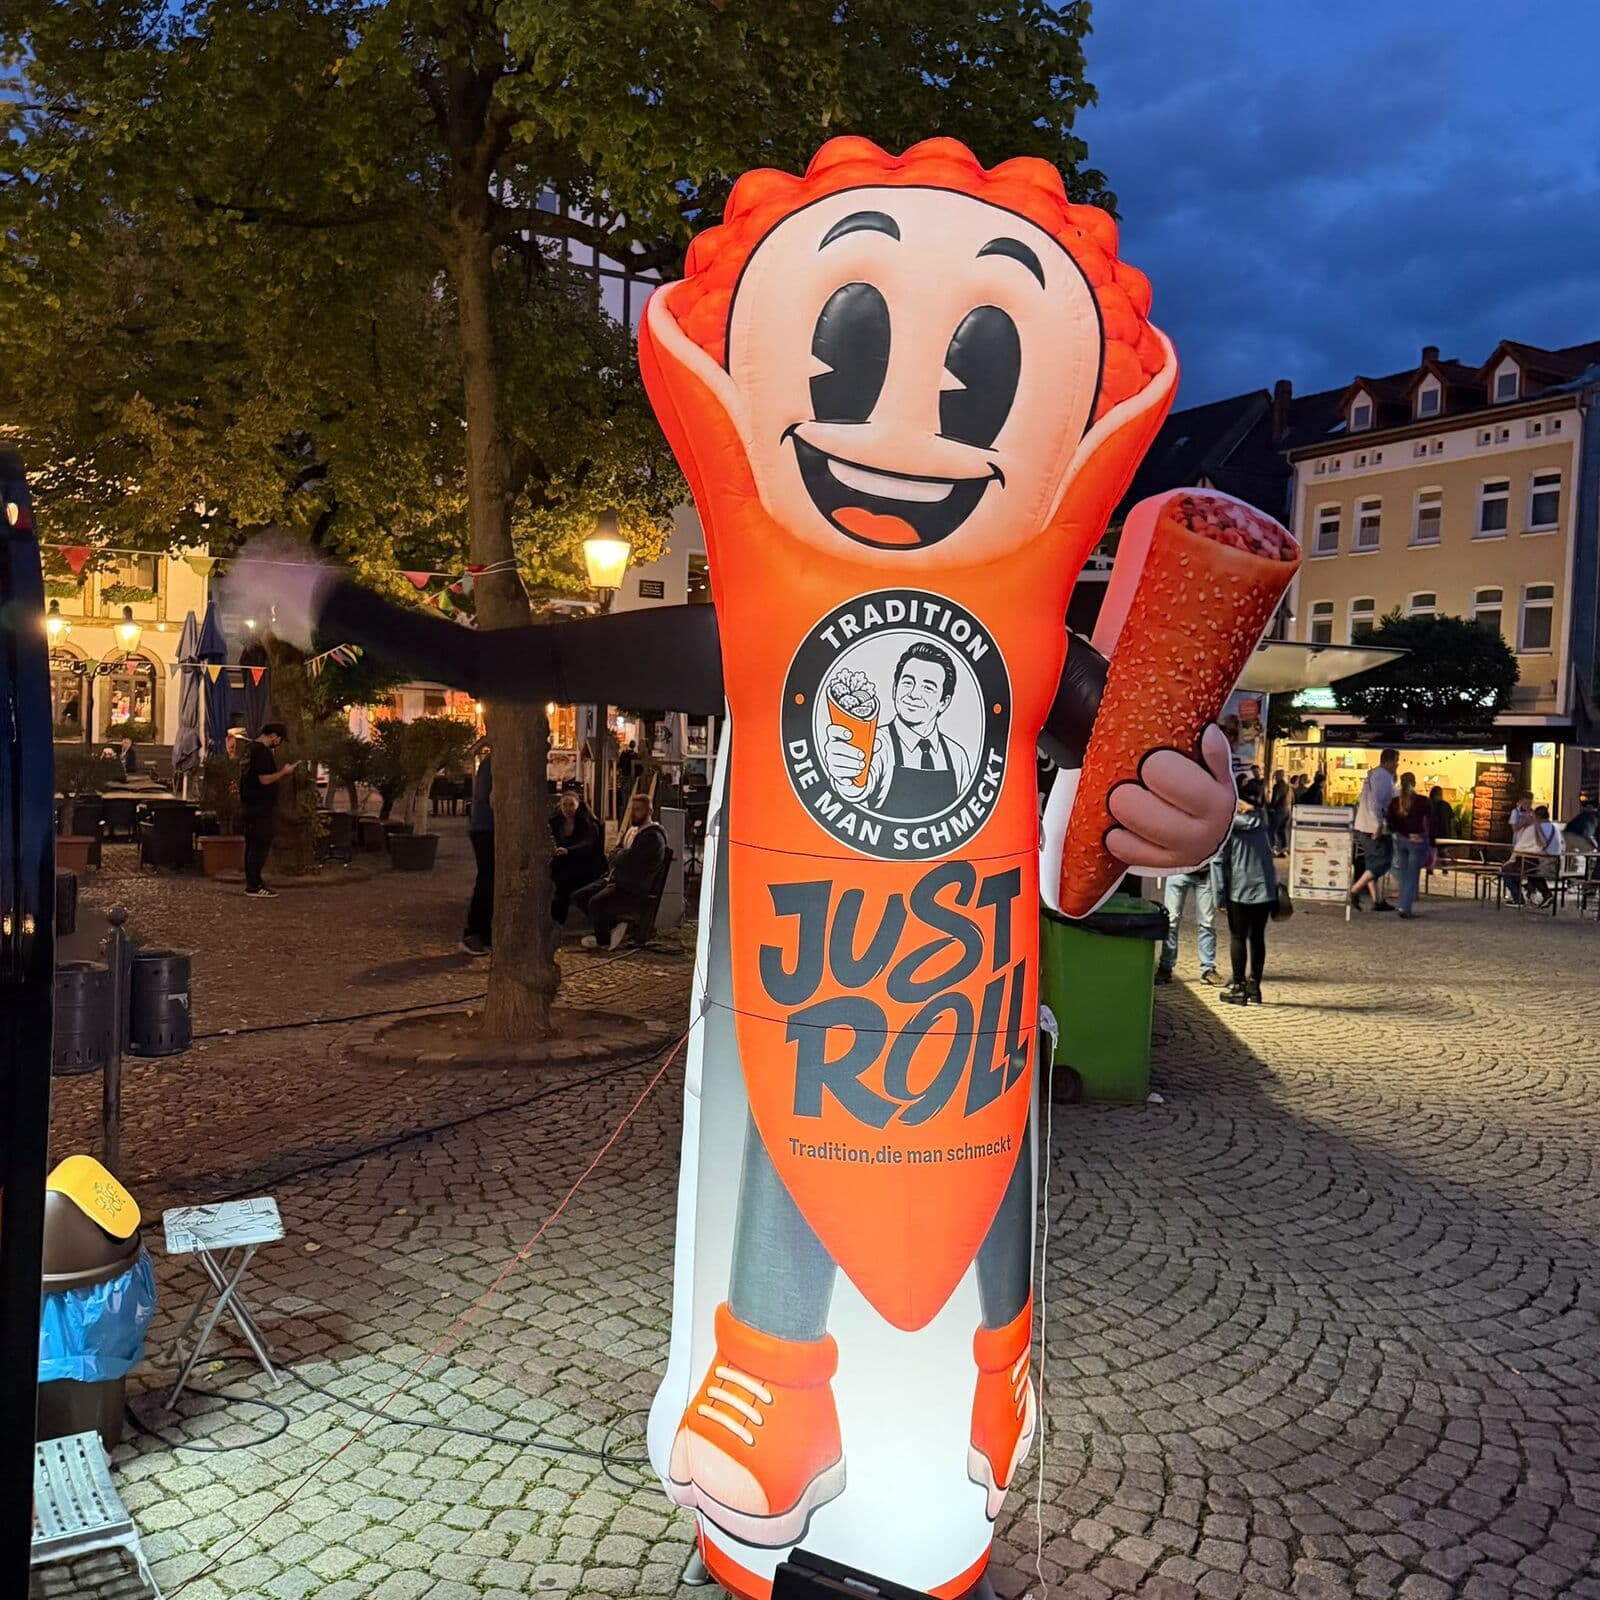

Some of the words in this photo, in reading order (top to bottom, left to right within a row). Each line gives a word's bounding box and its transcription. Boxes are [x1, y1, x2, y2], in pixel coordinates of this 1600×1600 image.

[820, 599, 989, 663] TRADITION
[788, 738, 820, 790] DIE
[814, 790, 882, 846] MAN
[892, 748, 1004, 851] SCHMECKT
[758, 860, 1022, 1006] JUST
[785, 955, 1030, 1130] ROLL
[907, 1148, 943, 1164] man
[946, 1134, 1012, 1162] schmeckt
